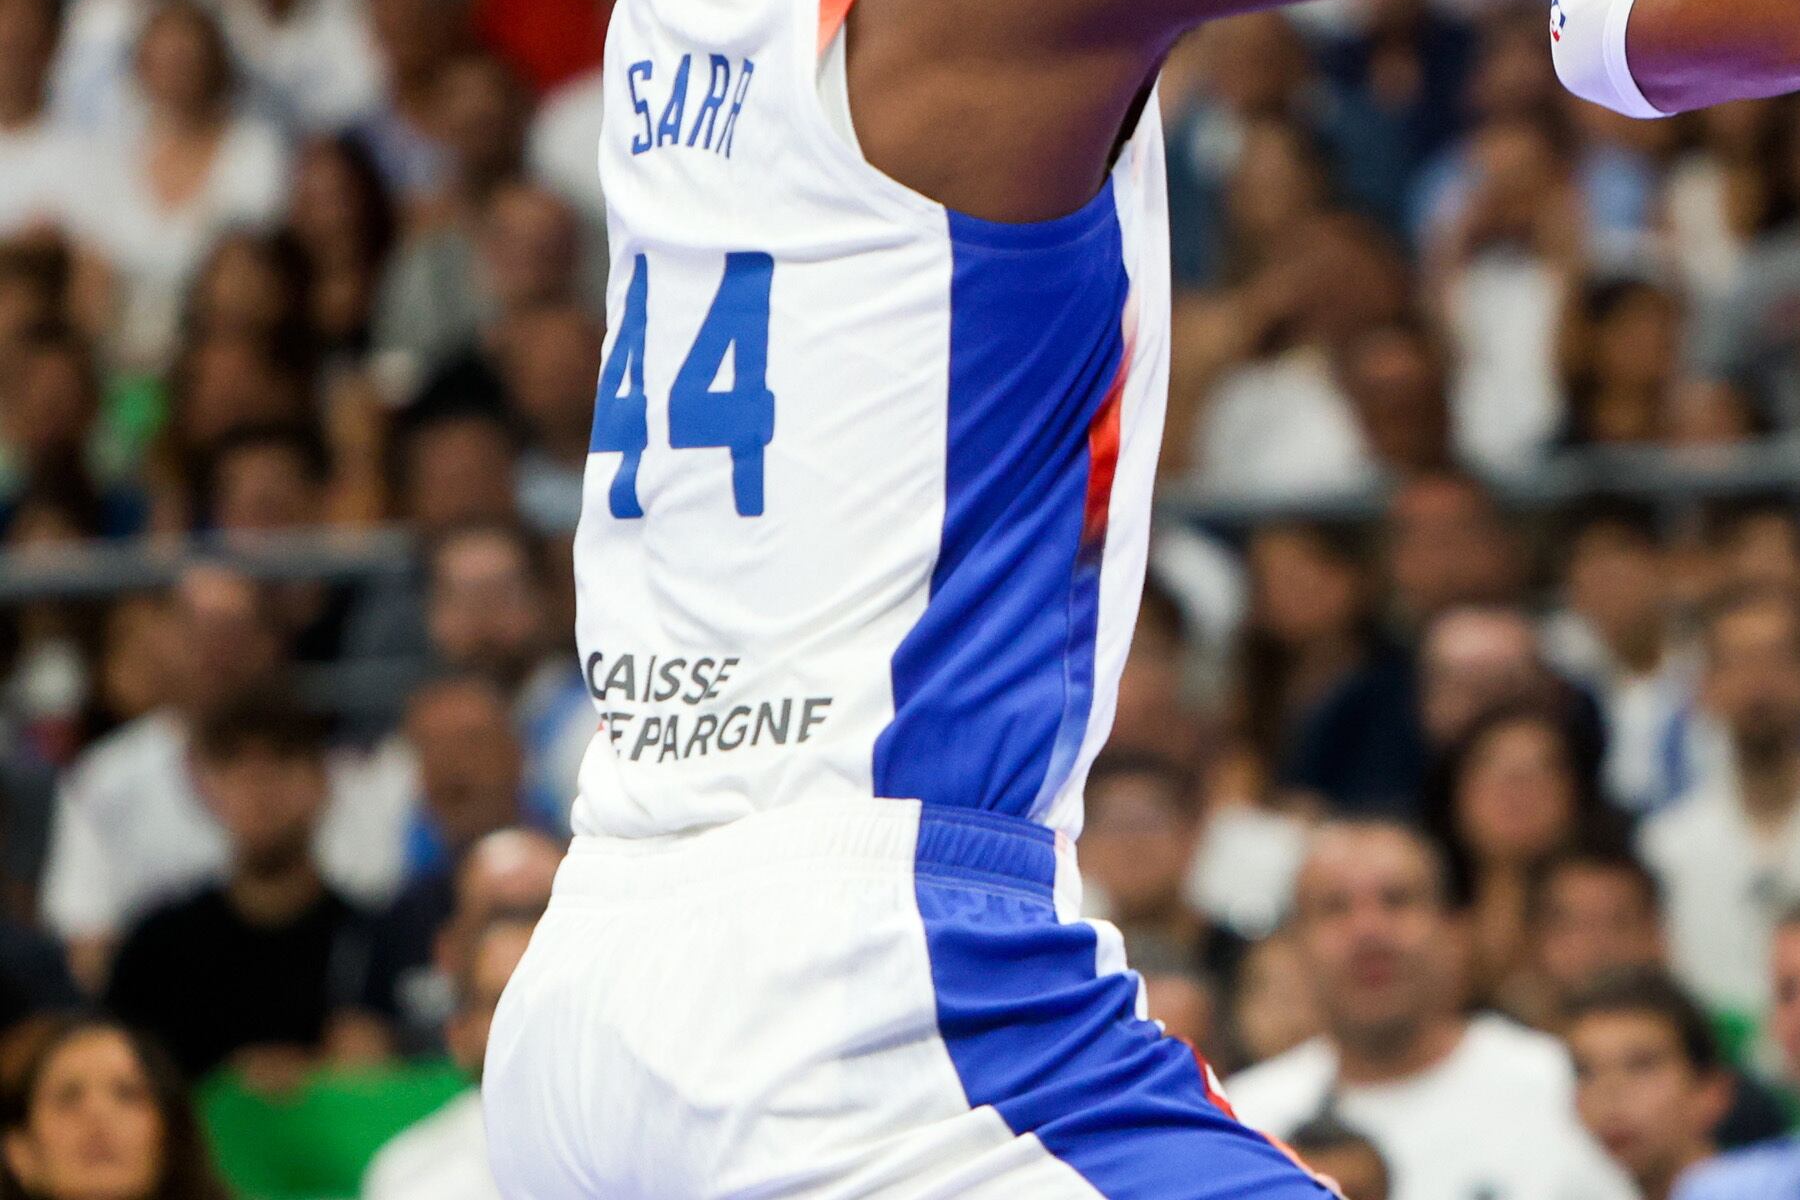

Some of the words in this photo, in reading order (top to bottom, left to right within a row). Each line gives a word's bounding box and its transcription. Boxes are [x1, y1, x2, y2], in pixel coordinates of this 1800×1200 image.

[627, 53, 754, 159] SARR
[588, 251, 775, 519] 44
[587, 651, 740, 705] CAISSE
